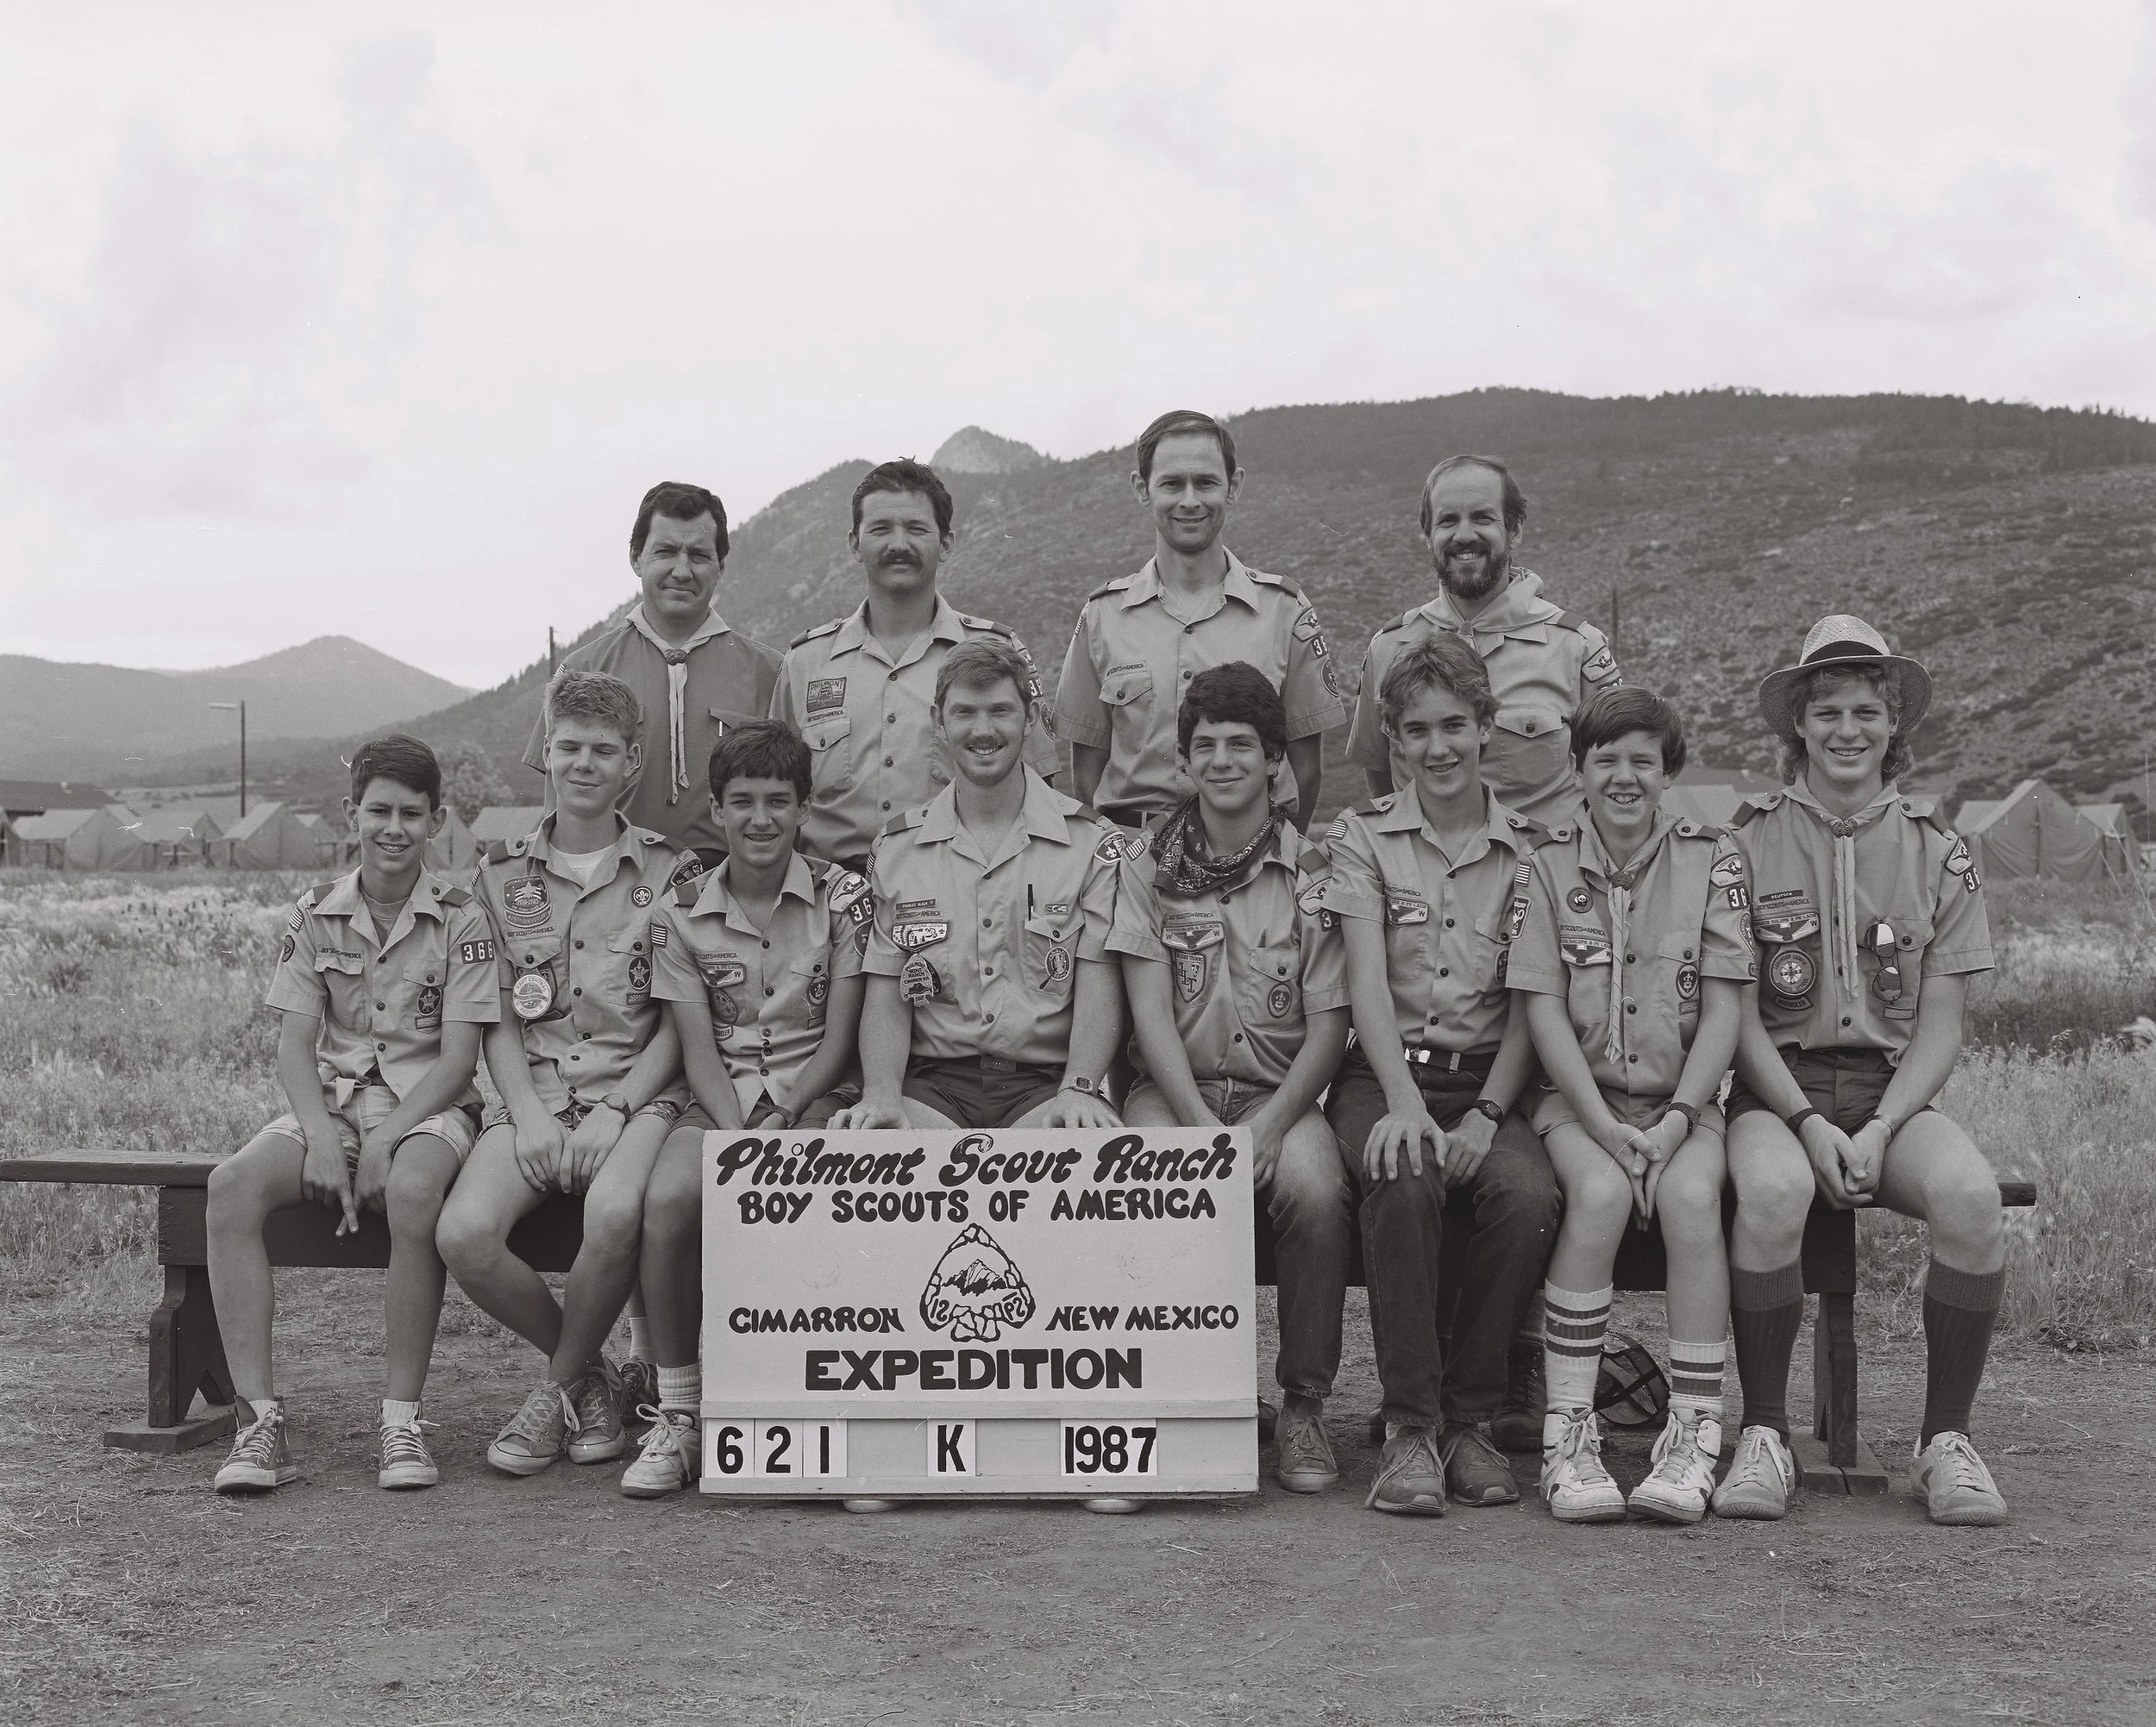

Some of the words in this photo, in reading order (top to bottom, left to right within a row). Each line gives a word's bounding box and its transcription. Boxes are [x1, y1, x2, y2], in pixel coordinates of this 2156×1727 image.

[851, 898, 872, 922] 36
[717, 1138, 926, 1186] Philmont
[939, 1134, 1081, 1186] Scout
[1094, 1133, 1237, 1183] Ranch
[740, 1191, 813, 1225] BOY
[832, 1190, 968, 1223] SCOUTS
[989, 1190, 1030, 1223] OF
[1050, 1188, 1216, 1222] AMERICA
[729, 1306, 906, 1335] CIMARRON
[1045, 1305, 1119, 1332] NEW
[1125, 1305, 1239, 1331] MEXICO
[805, 1348, 1143, 1392] EXPEDITION
[937, 1425, 967, 1473] K
[1065, 1425, 1157, 1474] 1987
